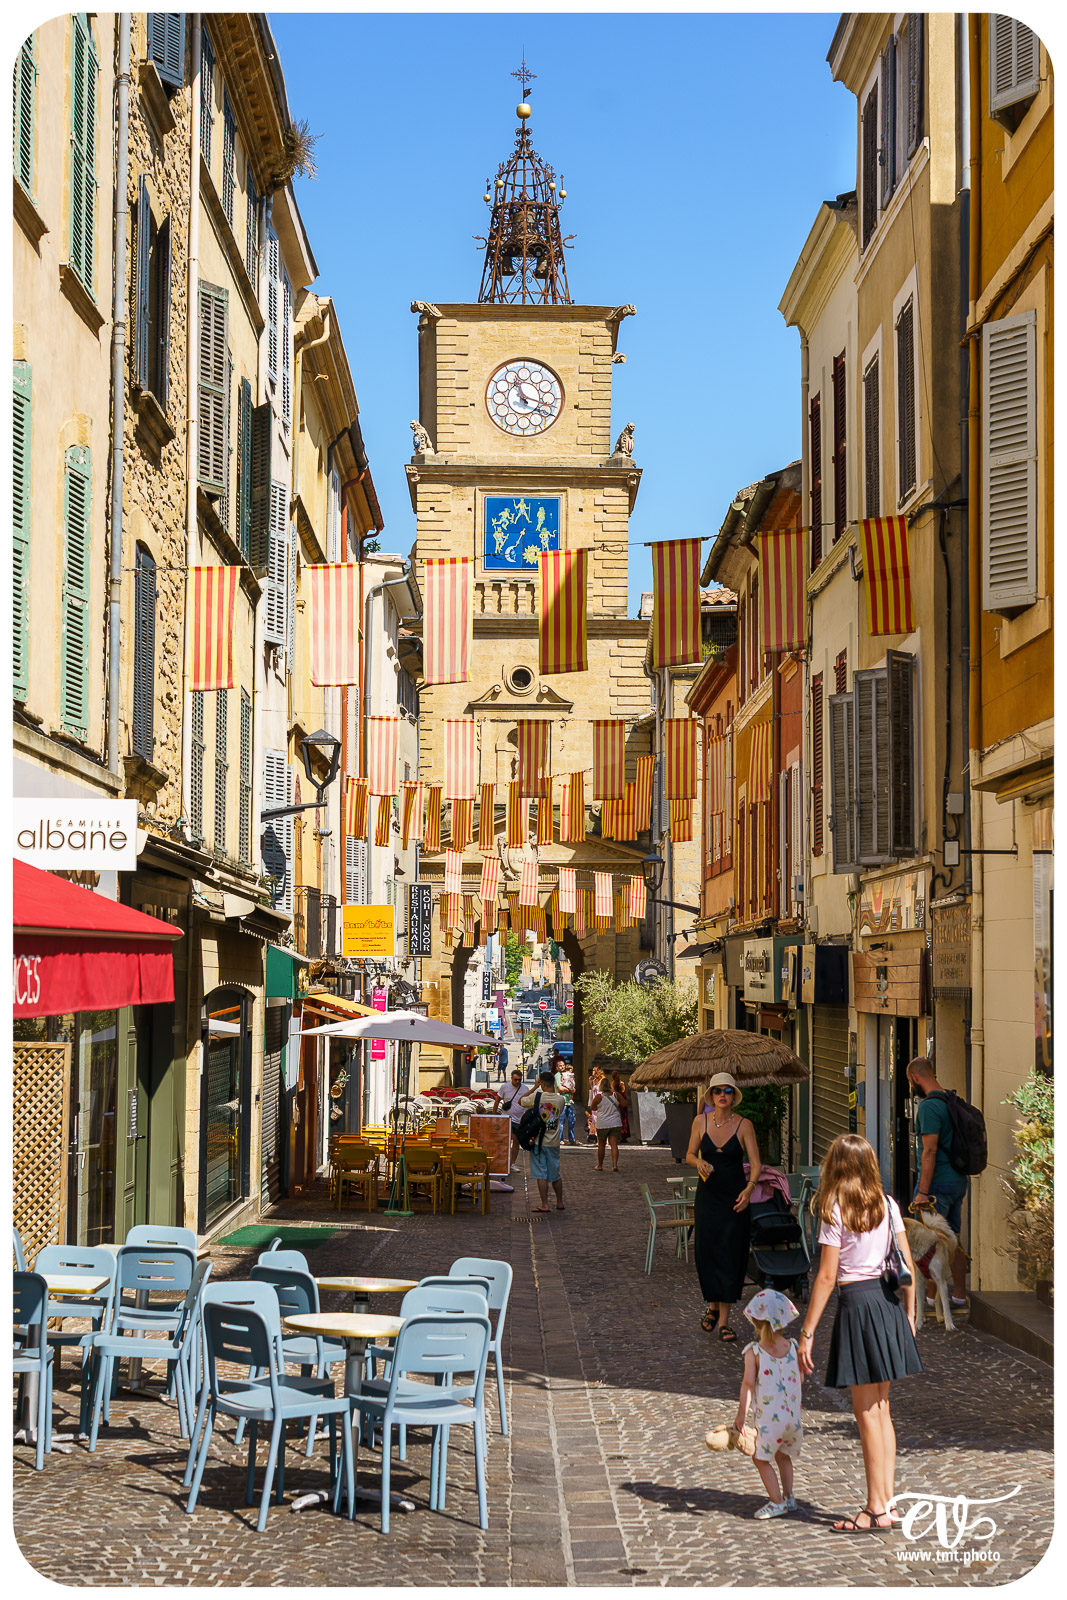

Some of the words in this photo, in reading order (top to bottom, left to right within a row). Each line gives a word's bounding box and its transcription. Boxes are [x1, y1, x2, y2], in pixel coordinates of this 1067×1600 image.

[17, 819, 127, 850] albane
[55, 819, 121, 828] CAMILLE
[410, 886, 419, 955] RESTAURANT
